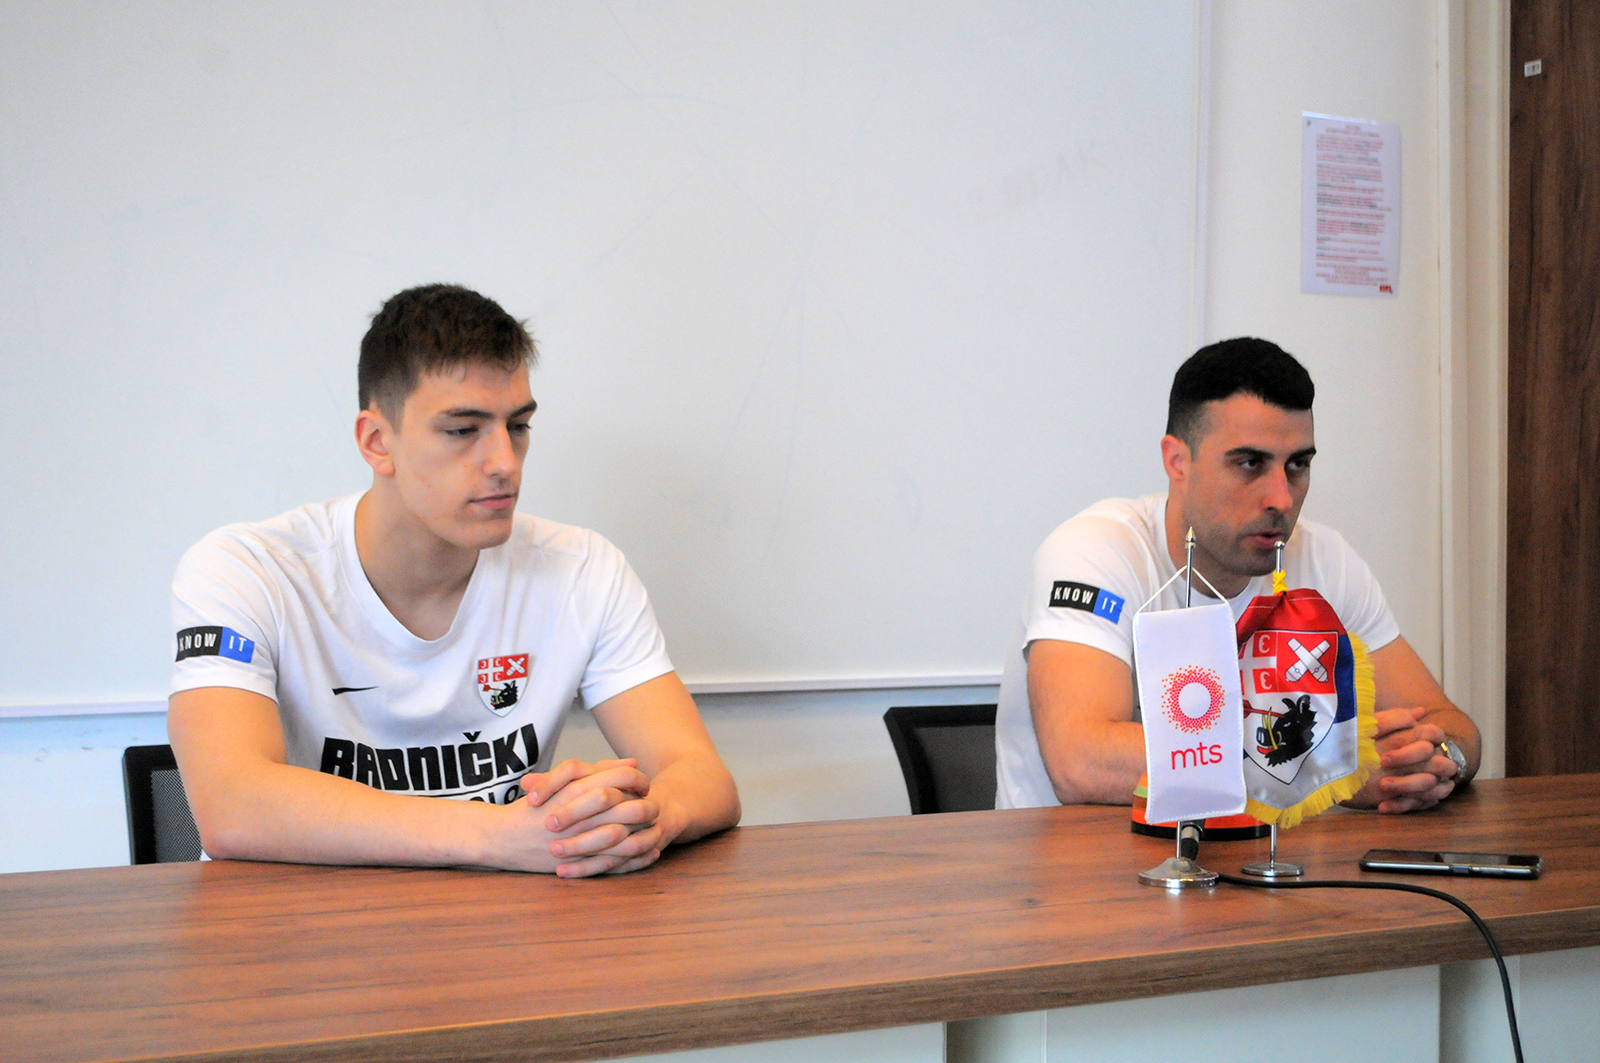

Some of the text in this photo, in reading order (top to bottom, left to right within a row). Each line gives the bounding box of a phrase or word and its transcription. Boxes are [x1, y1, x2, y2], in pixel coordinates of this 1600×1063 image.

[1053, 586, 1117, 613] KNOW IT
[179, 633, 247, 652] KNOW IT
[320, 723, 539, 791] RADNIČKI
[1171, 741, 1223, 770] mts
